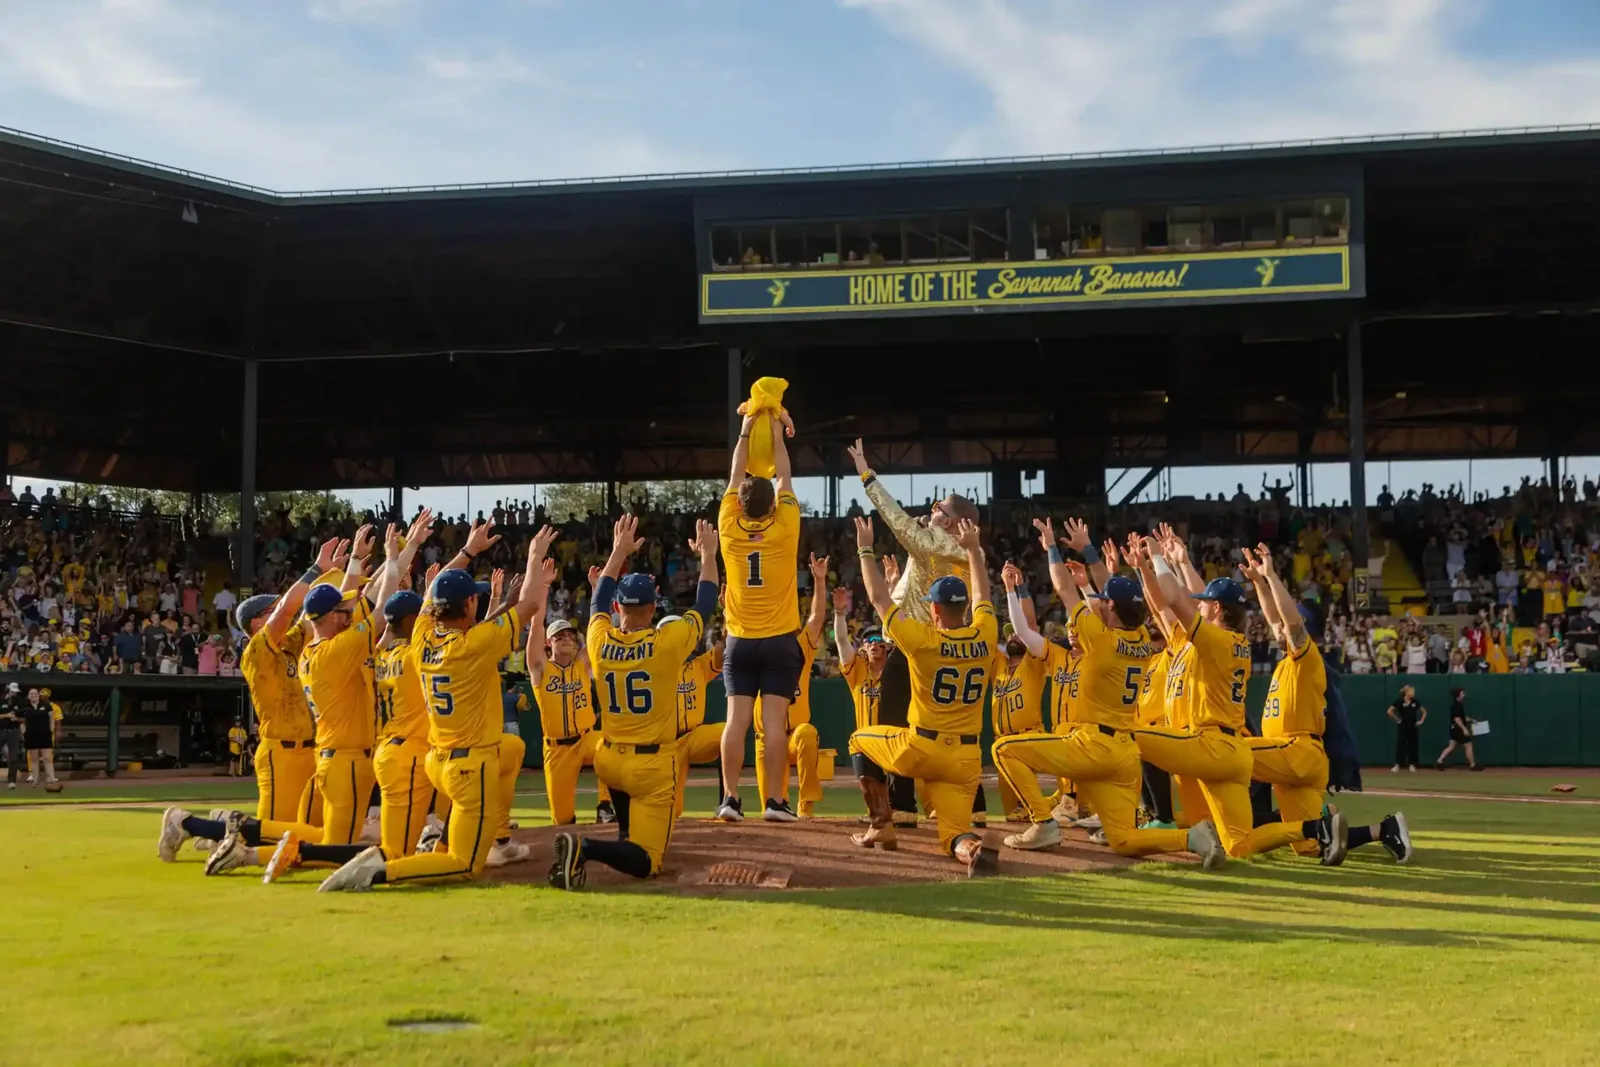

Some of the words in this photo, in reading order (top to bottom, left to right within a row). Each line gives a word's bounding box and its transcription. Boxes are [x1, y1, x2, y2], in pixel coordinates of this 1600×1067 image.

[850, 274, 906, 305] HOME
[910, 272, 936, 302] OF
[940, 270, 978, 301] THE
[987, 268, 1084, 299] Savannah
[1083, 263, 1189, 295] Bananas!
[747, 550, 764, 588] 1
[601, 642, 653, 661] VIRANT
[940, 640, 989, 659] GILLUM
[604, 670, 653, 714] 16
[932, 666, 985, 705] 66
[1008, 693, 1024, 713] 10
[1121, 666, 1142, 705] 5
